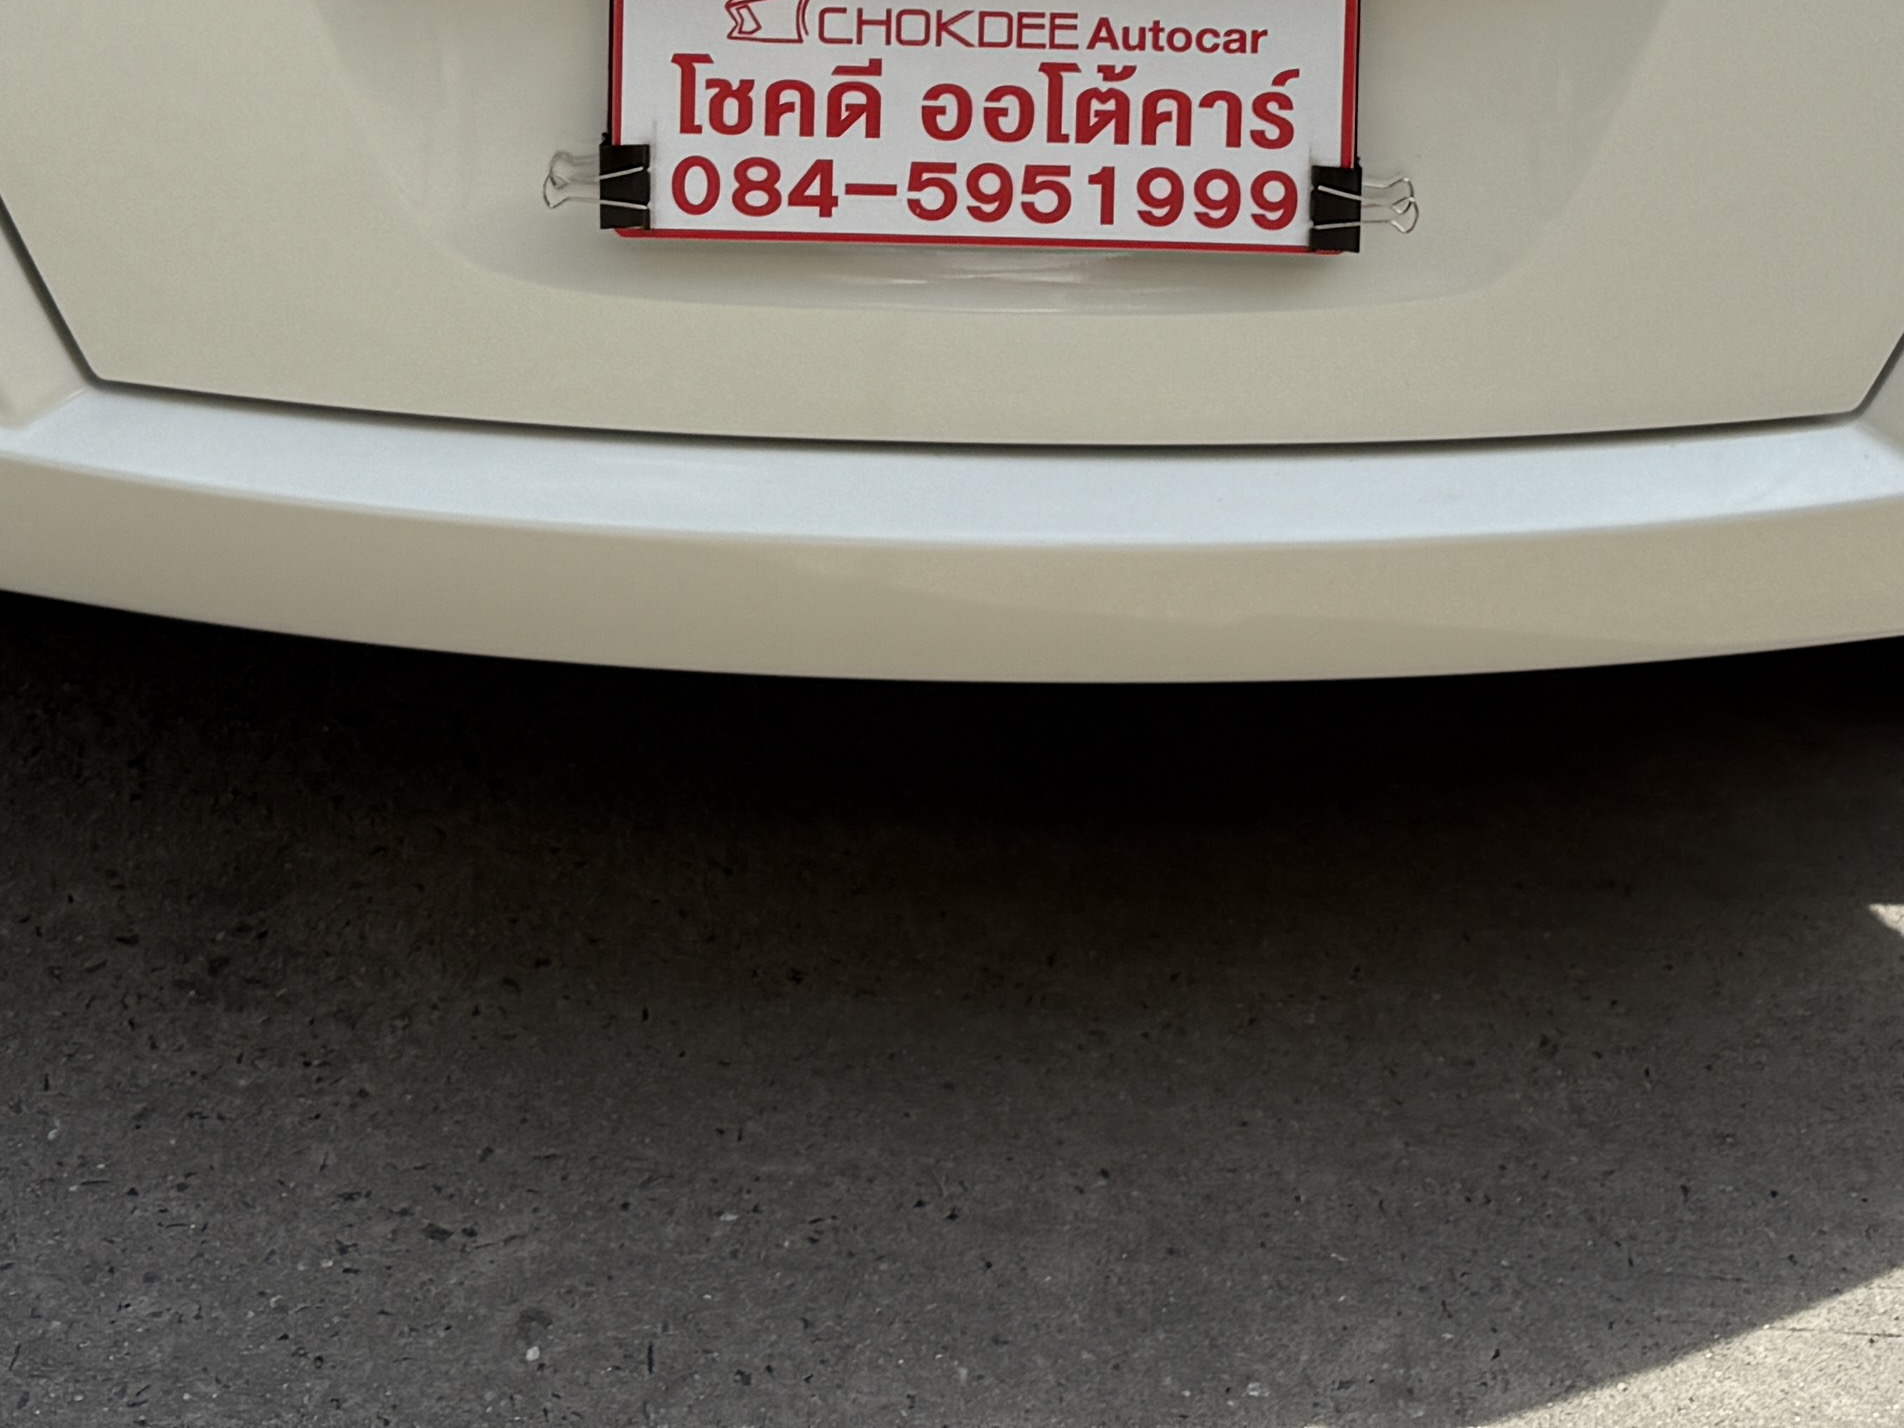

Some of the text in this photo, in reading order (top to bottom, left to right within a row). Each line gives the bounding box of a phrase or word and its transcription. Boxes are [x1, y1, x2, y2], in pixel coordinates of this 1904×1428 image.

[818, 7, 1269, 56] CHOKDEE Autocar
[671, 53, 1300, 150] โชคดี ออโต้คาร์
[669, 154, 1299, 232] 084-5951999
